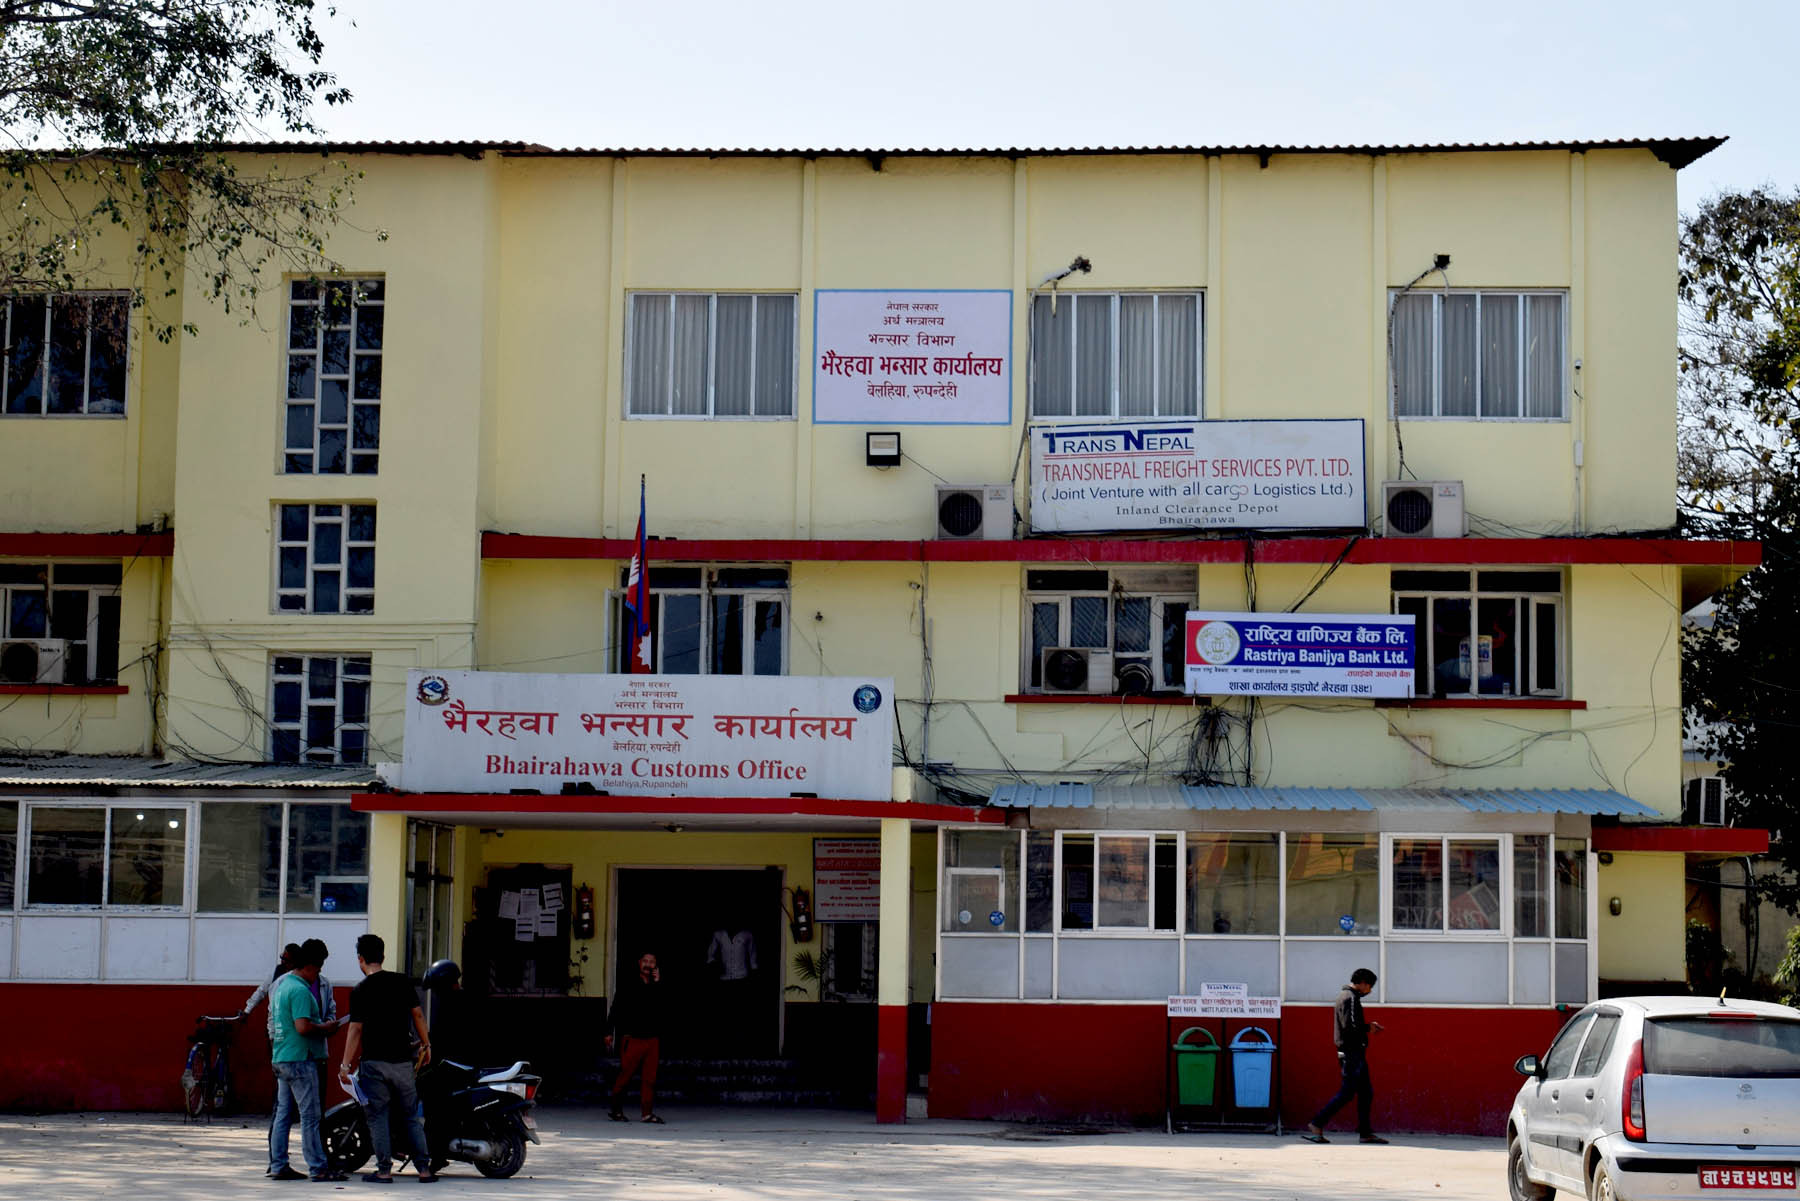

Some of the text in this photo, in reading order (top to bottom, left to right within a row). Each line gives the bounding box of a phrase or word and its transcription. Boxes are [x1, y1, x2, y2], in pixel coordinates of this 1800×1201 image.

[868, 332, 956, 346] भन्सार विभाग
[821, 350, 1003, 377] भैरहवा भन्सार कार्यालय
[1042, 428, 1194, 454] TRANS NEPAL
[1042, 458, 1352, 482] TRANSNEPAL FREIGHT SERVICES PVT. LTD.
[1051, 488, 1085, 501] Joint
[1090, 487, 1144, 499] Venture
[1150, 485, 1176, 497] with
[1183, 482, 1200, 496] all
[1205, 485, 1249, 500] cargo
[1254, 483, 1316, 498] Logistics
[1116, 503, 1279, 515] Inland Clearance Depot
[1296, 626, 1351, 643] वाणिज्य
[1385, 628, 1408, 644] लि.
[1244, 647, 1408, 665] Rastriya Banijya Bank Ltd.
[442, 699, 857, 740] भैरहवा भन्सार कार्यालय
[485, 754, 807, 780] Bhairahawa Customs Office
